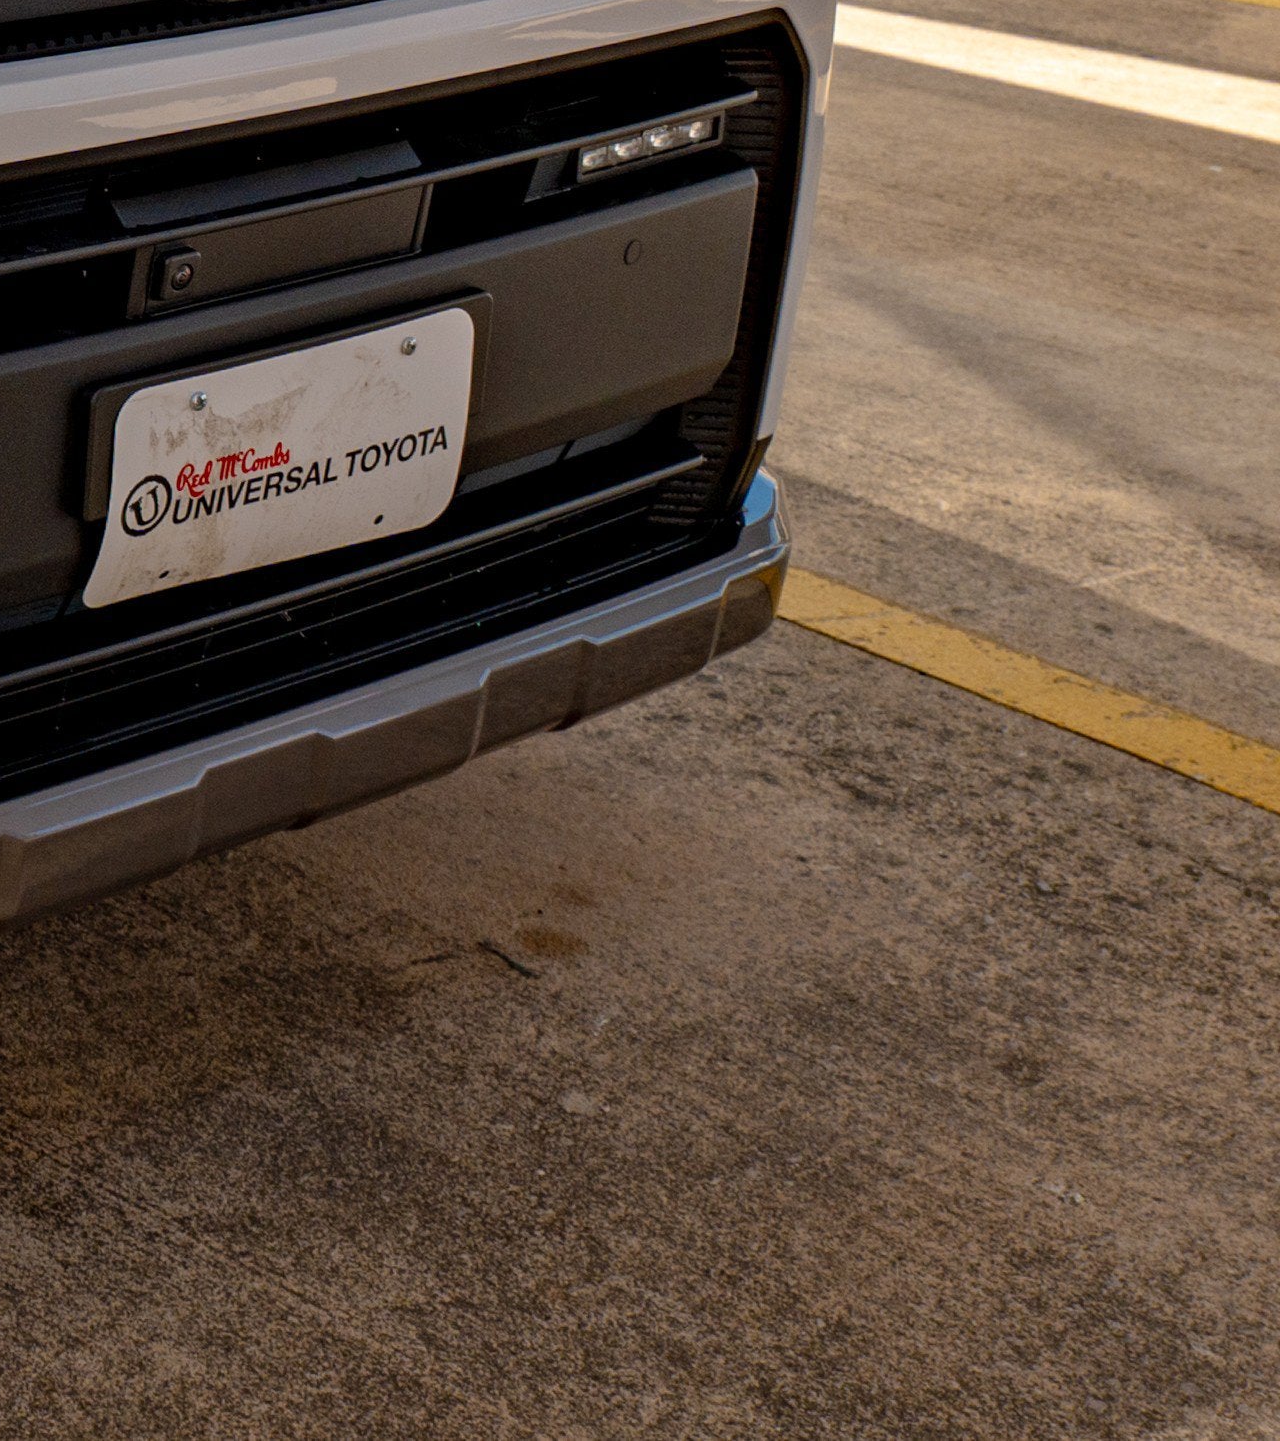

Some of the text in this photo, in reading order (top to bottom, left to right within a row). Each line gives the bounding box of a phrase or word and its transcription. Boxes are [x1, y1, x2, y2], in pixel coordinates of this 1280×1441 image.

[173, 459, 337, 524] UNIVERSAL
[345, 425, 449, 477] TOYOTA
[176, 441, 291, 498] Red McCombs
